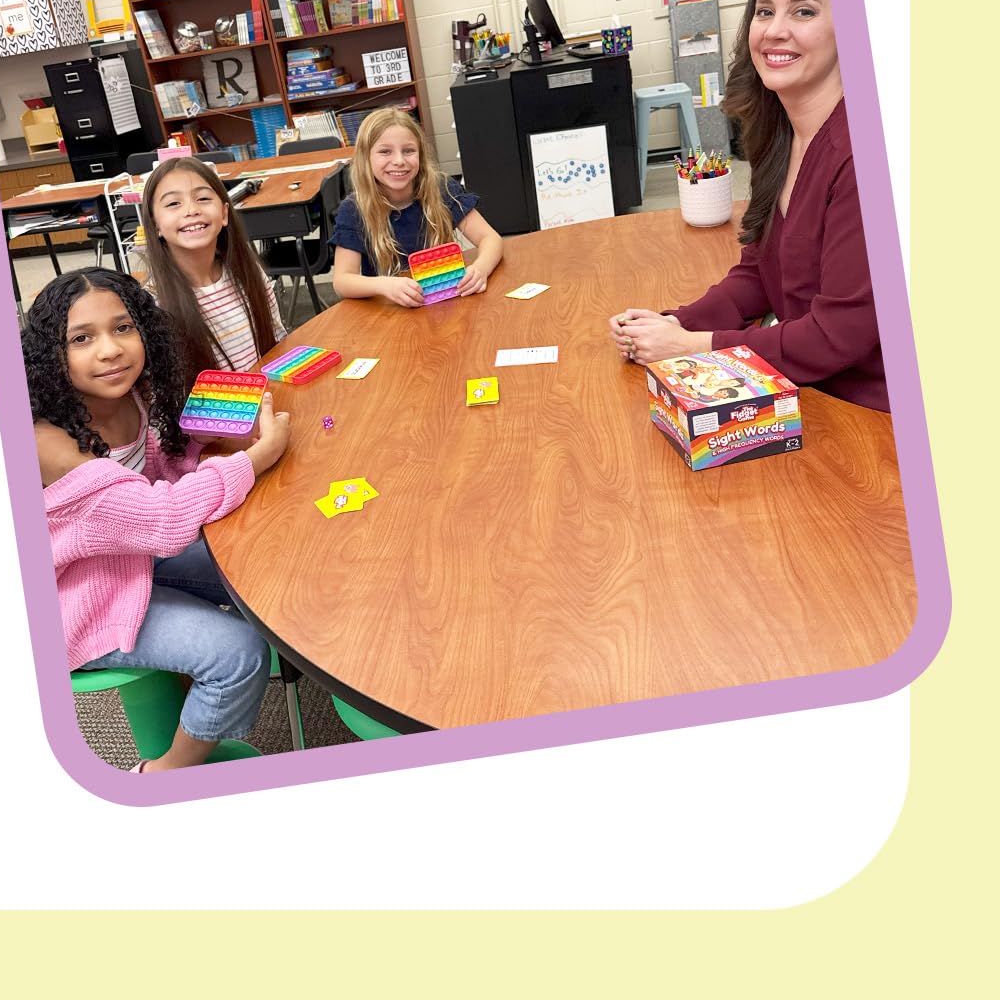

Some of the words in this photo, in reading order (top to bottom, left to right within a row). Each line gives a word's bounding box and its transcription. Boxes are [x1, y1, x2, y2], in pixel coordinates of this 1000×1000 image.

[8, 13, 24, 23] me
[370, 49, 408, 64] WELCOME
[371, 65, 382, 75] TO
[386, 63, 401, 73] 3RD
[211, 57, 249, 99] R
[731, 409, 759, 420] Fidget
[708, 430, 742, 450] Sight
[744, 422, 786, 438] Words
